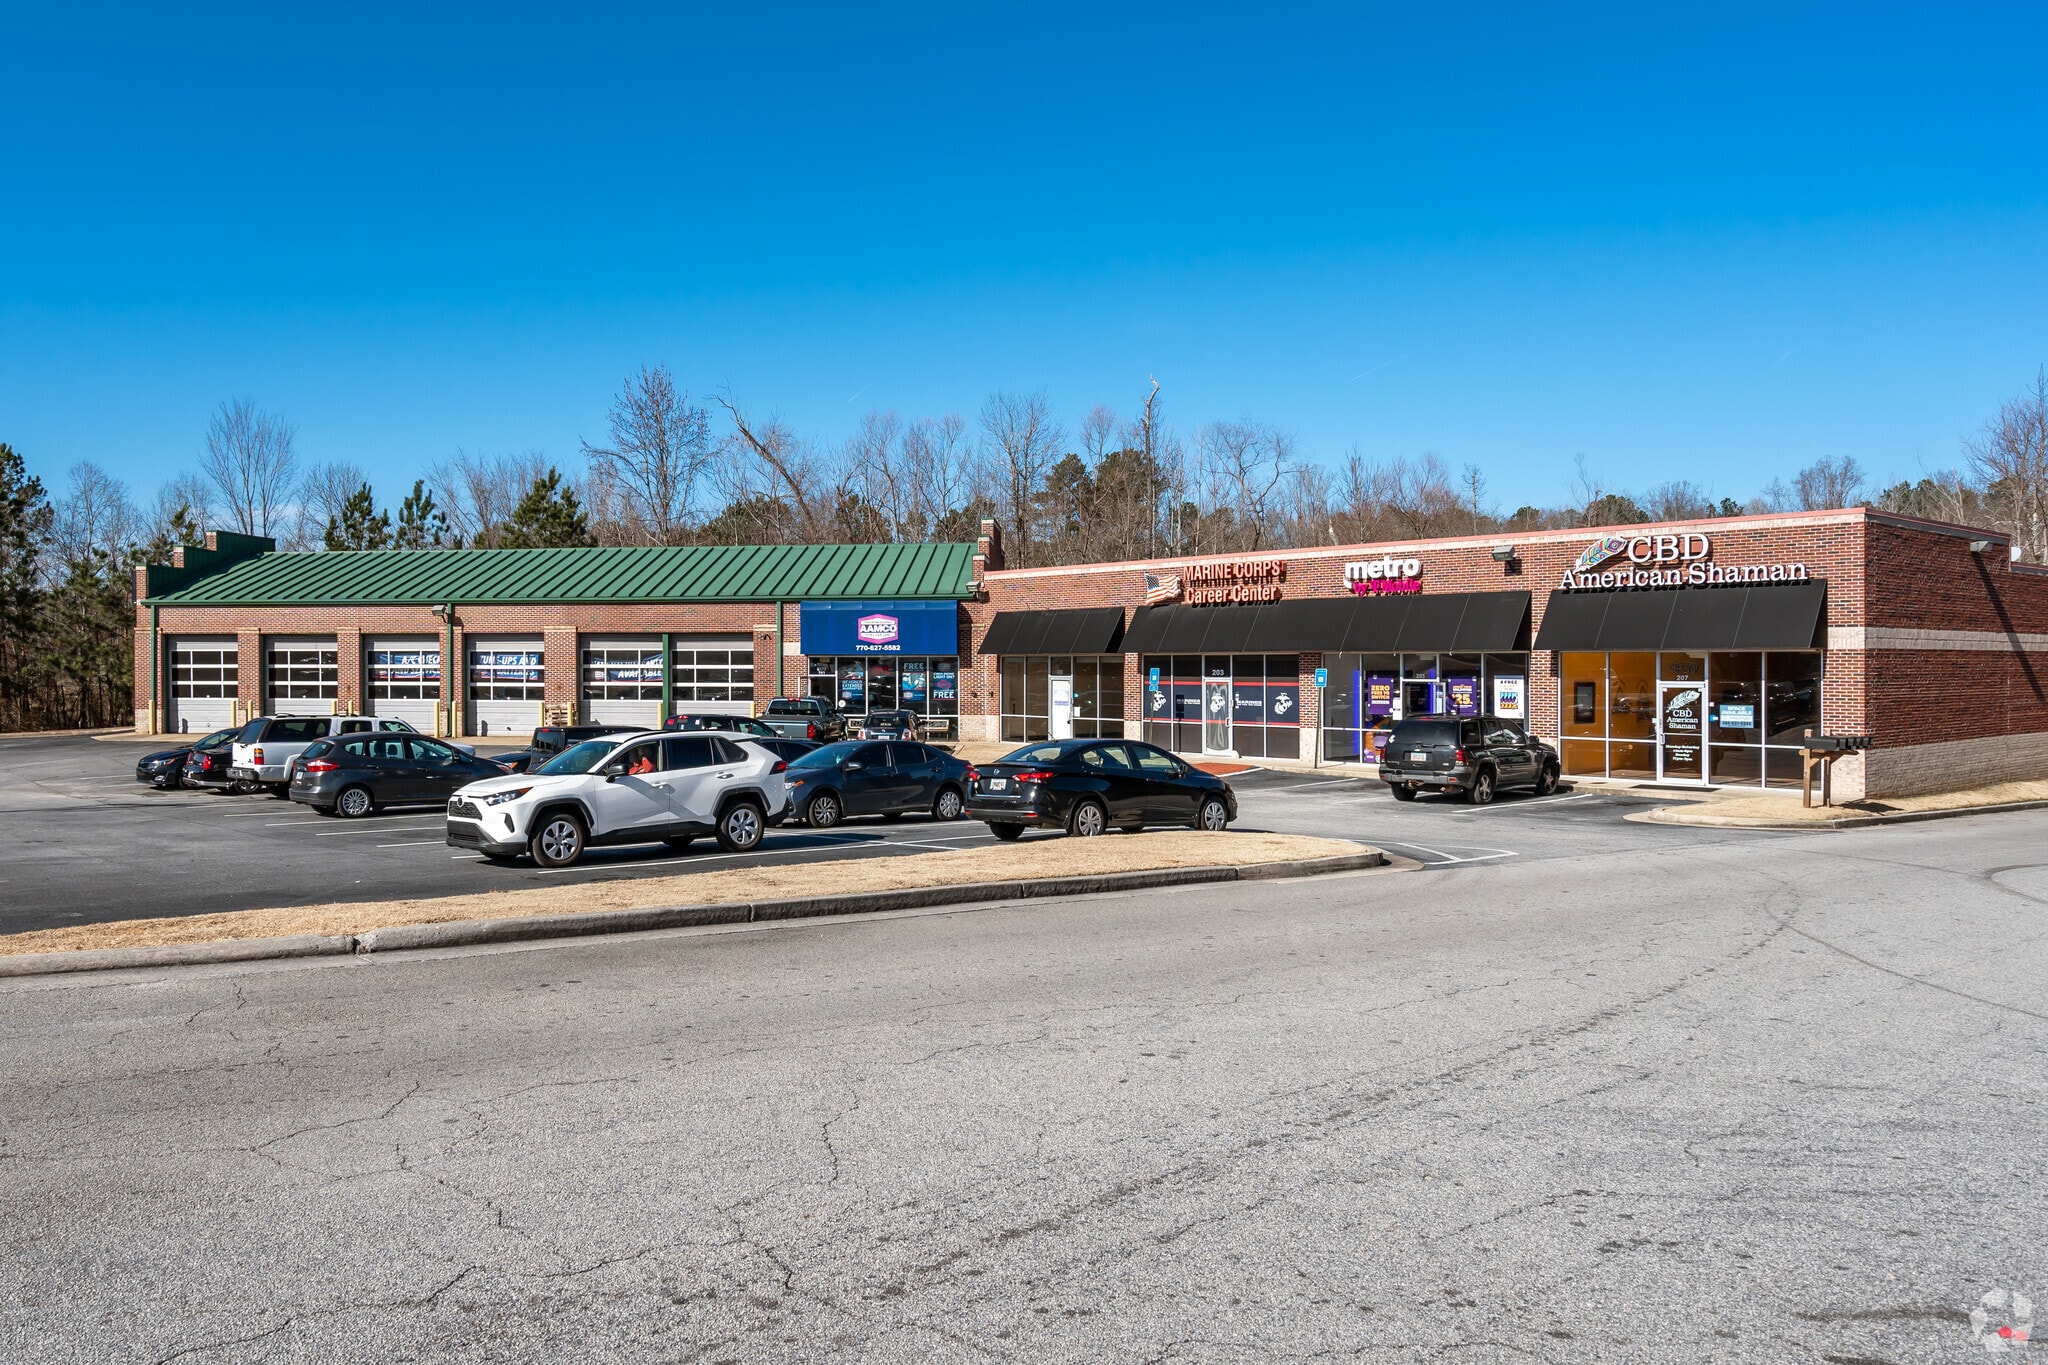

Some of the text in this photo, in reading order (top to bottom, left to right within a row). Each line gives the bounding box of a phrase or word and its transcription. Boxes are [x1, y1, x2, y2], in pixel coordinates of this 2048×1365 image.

[1627, 533, 1709, 563] CBD
[1183, 559, 1280, 581] MARINE CORPS
[1344, 555, 1420, 585] metro
[1558, 562, 1809, 590] American Shaman
[1186, 584, 1277, 604] Career Center
[1353, 580, 1369, 597] by
[860, 624, 897, 633] AAMCO
[903, 662, 925, 670] FREE
[933, 691, 955, 699] FREE
[1672, 709, 1693, 718] CBD
